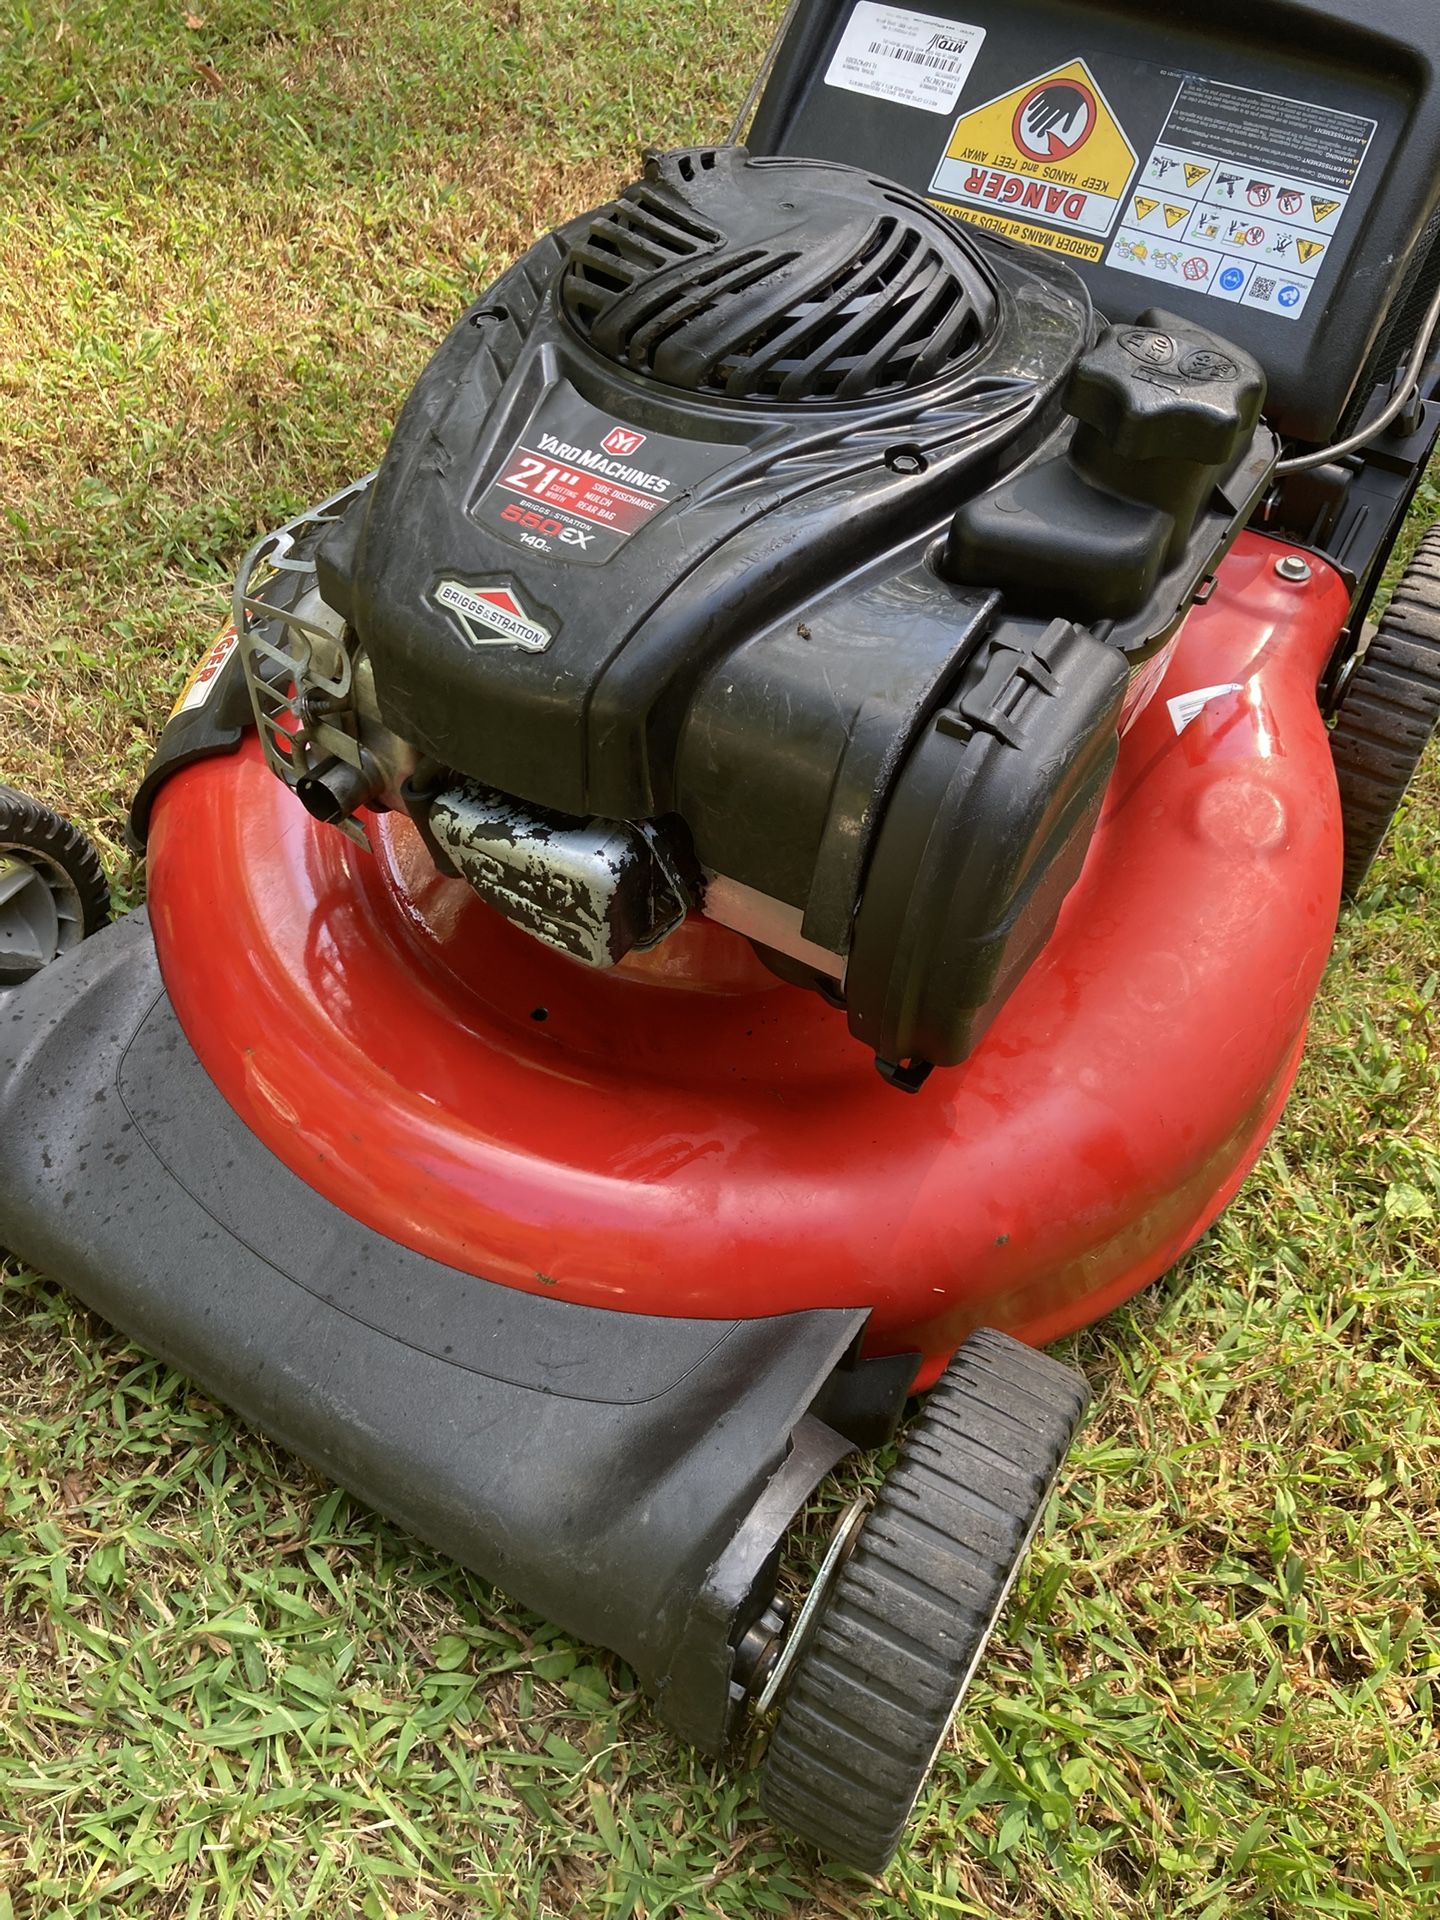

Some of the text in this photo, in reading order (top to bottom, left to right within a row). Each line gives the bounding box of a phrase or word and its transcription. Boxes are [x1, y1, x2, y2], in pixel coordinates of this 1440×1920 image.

[938, 39, 967, 54] MTD
[961, 147, 1109, 192] KEEP HANDS and FEET AWAY
[964, 168, 1087, 220] DANGER
[979, 216, 1008, 233] PIEDS
[1009, 225, 1020, 236] et
[1021, 230, 1055, 248] MAINS
[1056, 238, 1099, 258] GARDER
[536, 433, 671, 493] YARD MACHINES
[545, 490, 567, 503] WIDTH
[550, 484, 579, 499] CUTTING
[584, 492, 613, 507] MULCH
[592, 483, 657, 511] SIDE DISCHARGE
[520, 500, 550, 515] BRIGGS
[554, 513, 593, 531] STRATTON
[575, 501, 617, 521] REAR BAG
